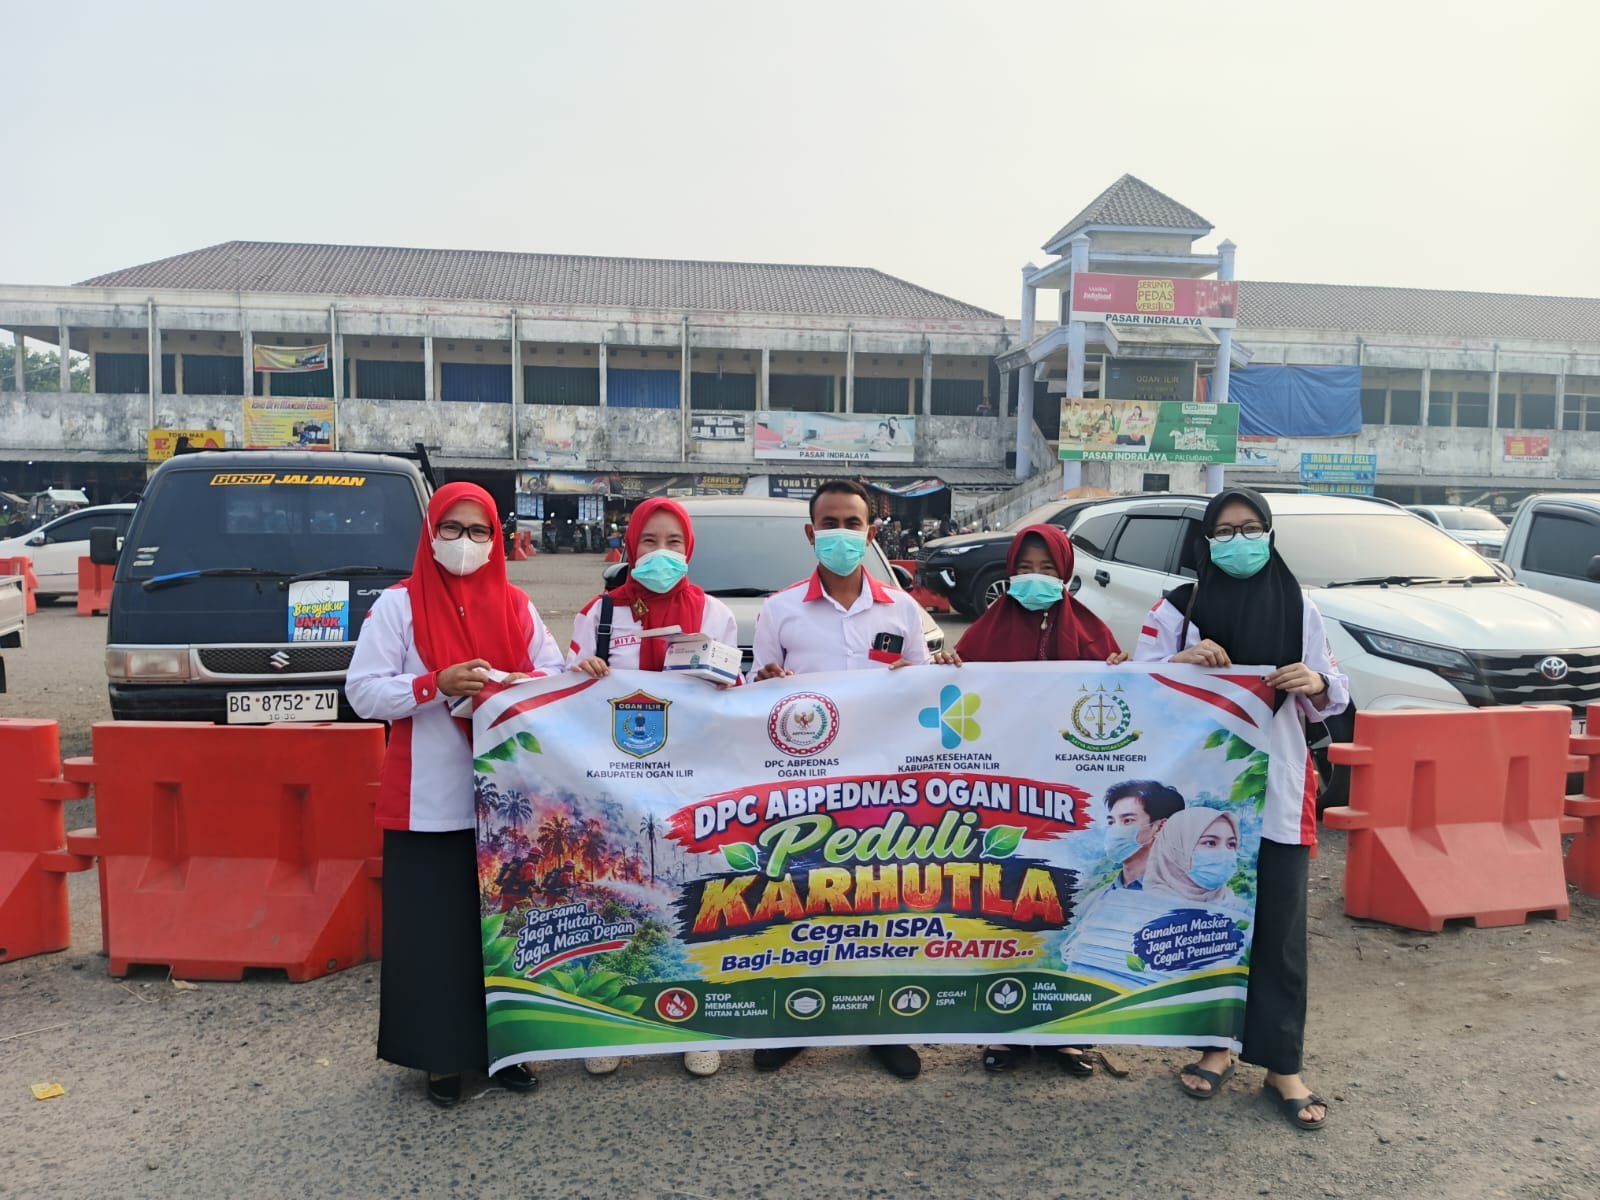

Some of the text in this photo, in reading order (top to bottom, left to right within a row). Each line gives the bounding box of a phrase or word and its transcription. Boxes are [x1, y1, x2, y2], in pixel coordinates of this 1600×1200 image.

[1138, 290, 1173, 301] PEDAS
[1105, 313, 1202, 326] PASAR INDRALAYA
[800, 451, 870, 459] PASAR INDRALAYA
[1082, 451, 1112, 461] PASAR
[1114, 452, 1168, 462] INDRALAYA
[211, 474, 366, 487] GOSIP JALANAN
[778, 479, 800, 487] TOKO
[292, 601, 345, 618] Bersyukur
[294, 616, 339, 628] UNTUK
[293, 627, 344, 642] Hari Ini
[230, 693, 334, 712] BG 8752 ZV
[764, 758, 839, 768] DPC ABPEDNAS
[905, 753, 992, 763] DINAS KESEHATAN
[1112, 754, 1146, 762] NEGERI
[609, 761, 671, 770] PEMERINTAH
[898, 763, 951, 772] KABUPATEN
[953, 762, 980, 770] OGAN
[1075, 764, 1125, 772] OGAN ILIR
[586, 770, 643, 778] KABUPATEN
[645, 770, 673, 778] OGAN
[777, 768, 827, 777] OGAN ILIR
[694, 778, 1075, 840] DPC ABPEDNAS OGAN ILIR
[758, 810, 978, 878] Peduli
[691, 862, 1066, 934] KARHUTLA
[527, 903, 585, 926] Bersama
[519, 914, 601, 948] Jaga Hutan,
[790, 917, 953, 946] Cegah ISPA,
[1141, 916, 1229, 940] Gunakan Masker
[515, 922, 633, 970] Jaga Masa Depan
[1146, 931, 1228, 955] Jaga Kesehatan
[720, 939, 1035, 972] Bagi-bagi Masker GRATIS...
[1153, 941, 1237, 966] Cegah Penularan
[1032, 982, 1056, 991] JAGA
[705, 994, 732, 1002] STOP
[937, 990, 967, 998] CEGAH
[1032, 992, 1092, 1002] LINGKUNGAN
[705, 1001, 756, 1010] MEMBAKAR
[832, 1002, 868, 1010] MASKER
[1032, 1002, 1052, 1011] KITA
[742, 1009, 768, 1017] LAHAN
